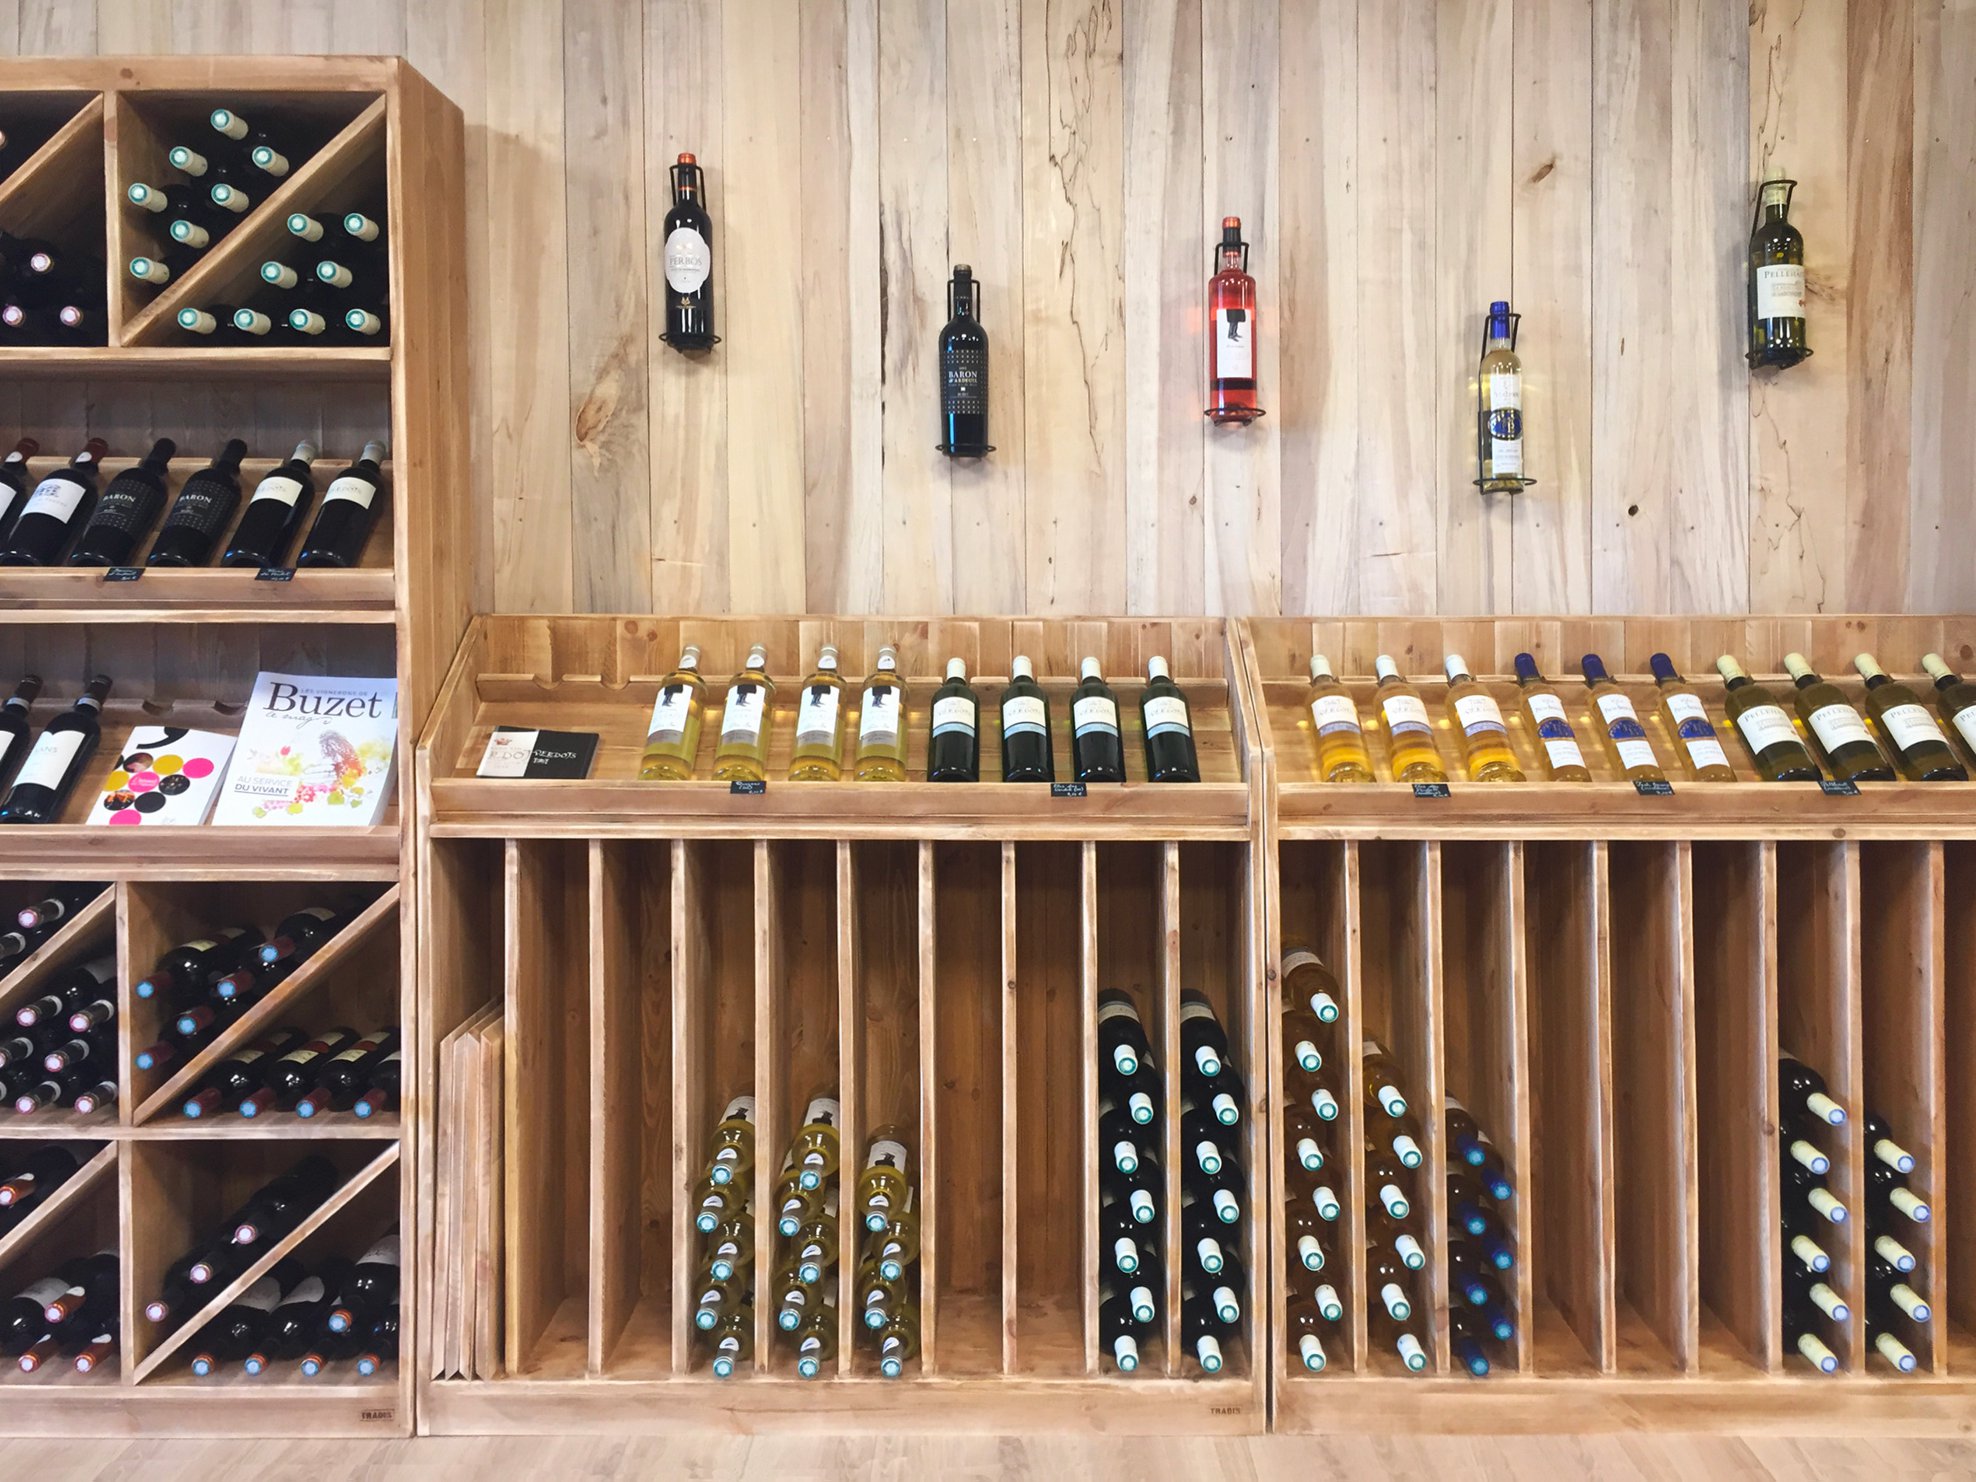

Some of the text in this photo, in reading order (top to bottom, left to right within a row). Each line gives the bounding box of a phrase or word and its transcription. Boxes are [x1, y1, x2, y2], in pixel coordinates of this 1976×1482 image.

[948, 371, 978, 379] BARON
[102, 493, 136, 503] BARON
[179, 493, 212, 504] BARON
[262, 681, 383, 719] Buzet
[237, 775, 293, 787] AU SERVICE
[234, 783, 289, 795] DU VIVANT
